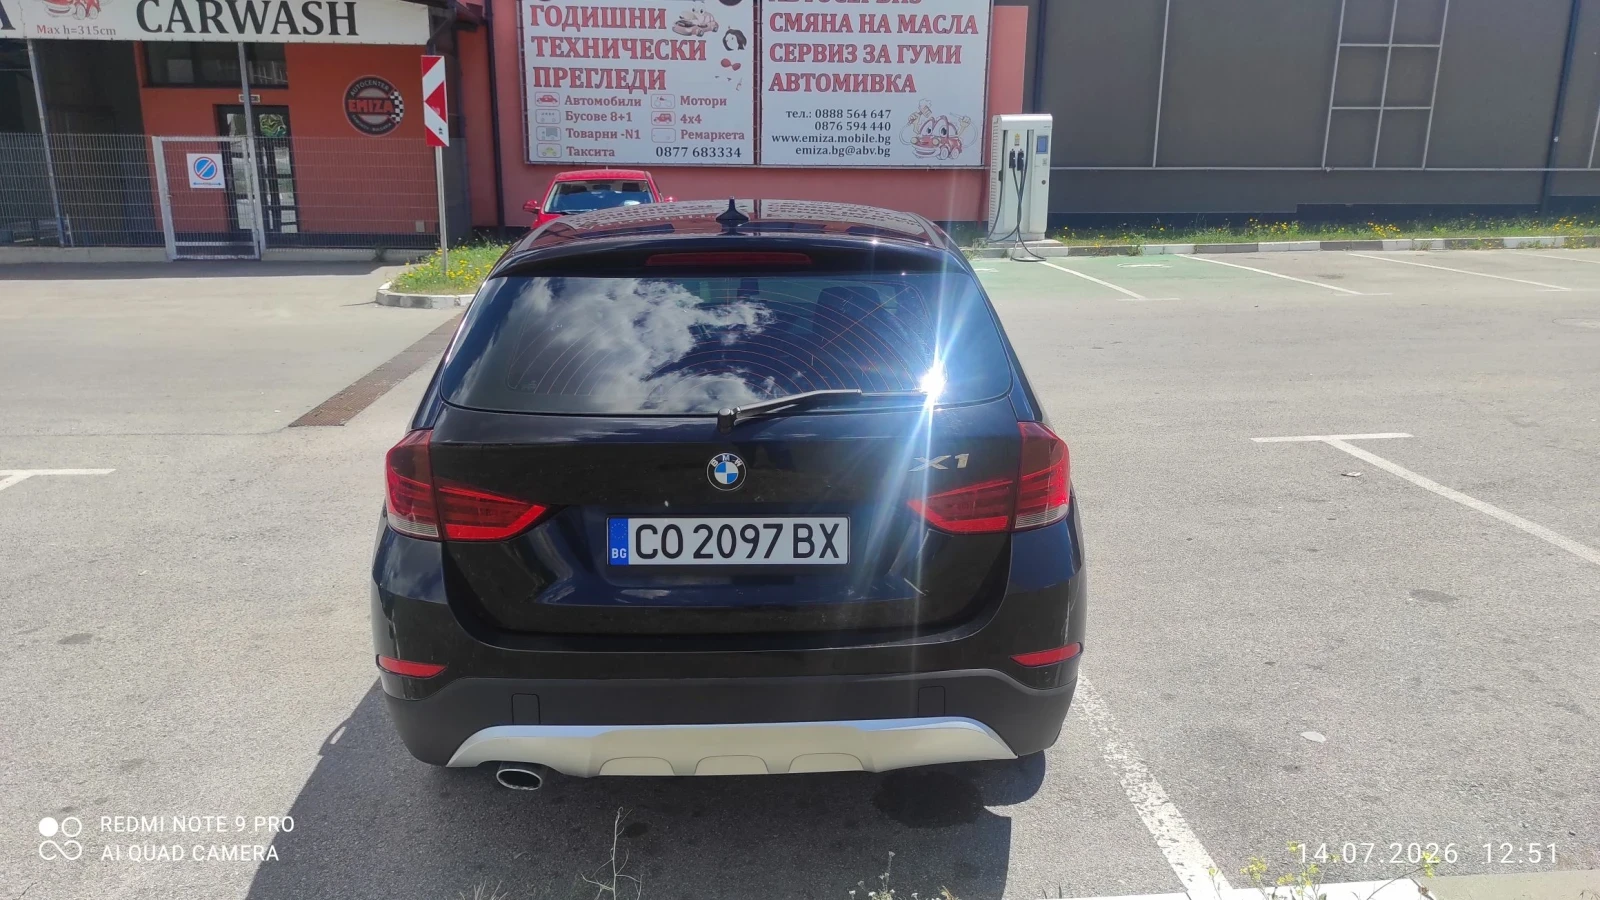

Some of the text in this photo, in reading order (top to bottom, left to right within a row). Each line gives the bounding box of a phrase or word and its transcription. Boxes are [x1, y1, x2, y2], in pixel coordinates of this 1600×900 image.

[136, 0, 359, 37] CARWASH
[530, 5, 667, 32] ГОДИШНИ
[769, 12, 979, 35] СМЯНА НА МАСЛА
[36, 24, 117, 36] Max h=315cm
[531, 36, 706, 61] ТЕХНИЧЕСКИ
[769, 43, 963, 65] СЕРВИЗ ЗА ГУМИ
[533, 67, 667, 94] ПРЕГЛЕДИ
[768, 73, 917, 94] АВТОМИВКА
[350, 80, 389, 97] AUTOCENTER
[348, 100, 394, 113] EMIZA
[564, 95, 642, 107] Автомобили
[680, 95, 727, 109] Мотори
[565, 111, 632, 122] Бусове 8+1
[786, 109, 892, 119] тел.: 0888 564 647
[814, 121, 891, 131] 0876 594 440
[566, 128, 641, 140] Товарни -N1
[680, 130, 745, 142] Ремаркета
[771, 133, 891, 146] www.emiza.mobile.bg
[566, 146, 615, 157] Таксита
[655, 147, 742, 158] 0877 683334
[795, 145, 891, 158] emiza.bg@abv.bg
[710, 454, 744, 467] BMW
[909, 453, 970, 472] X1
[635, 523, 840, 560] CO 2097 BX
[611, 548, 627, 559] BG
